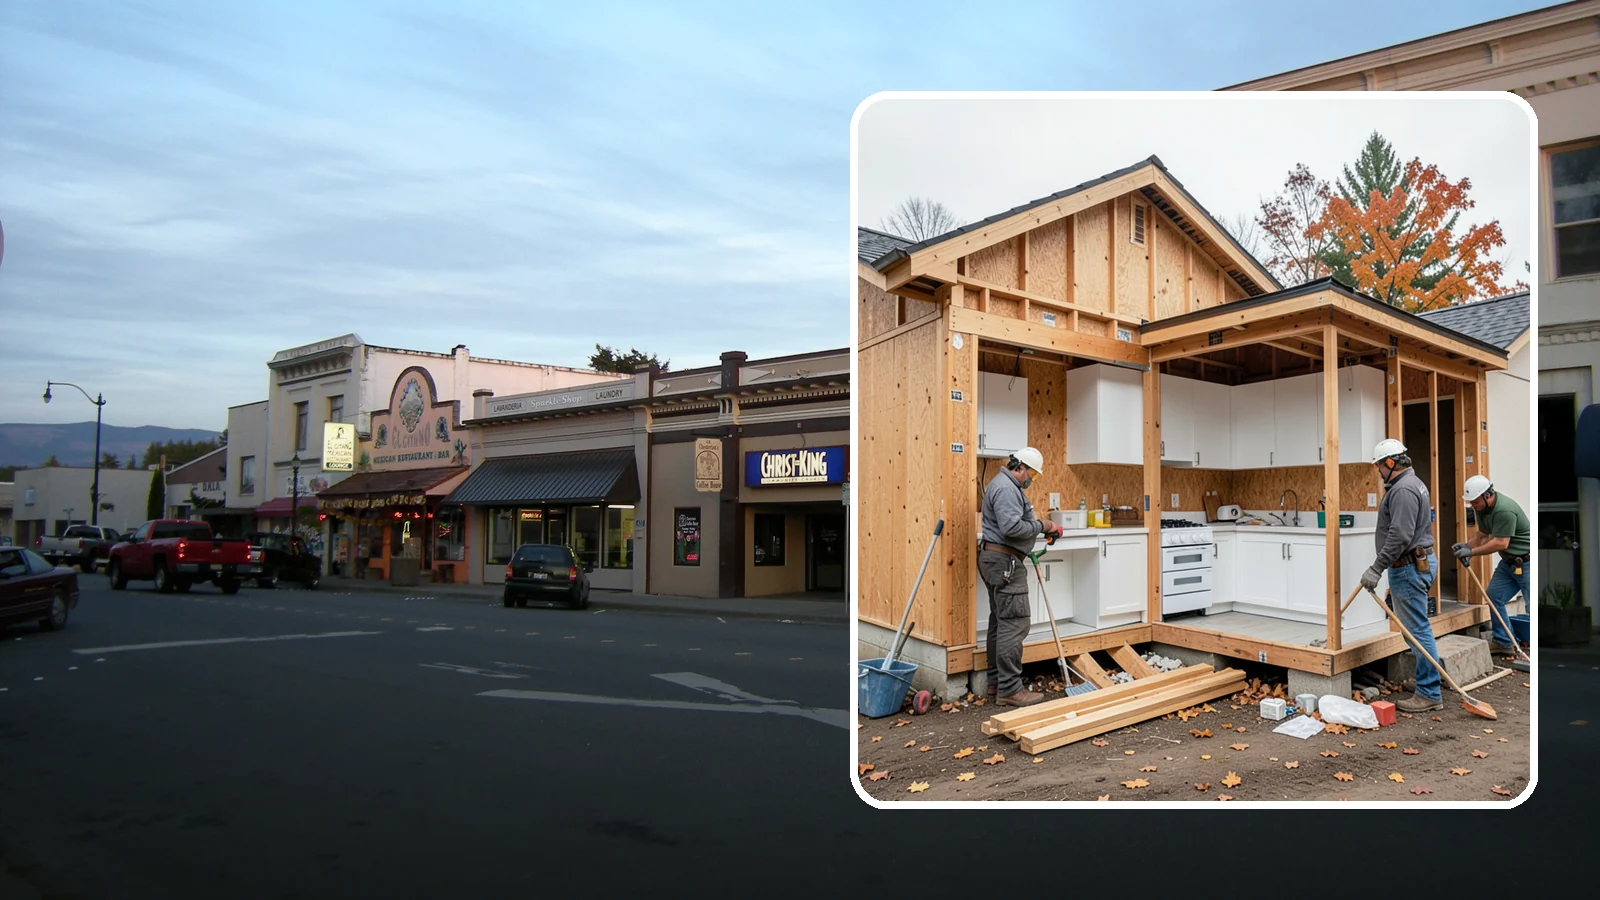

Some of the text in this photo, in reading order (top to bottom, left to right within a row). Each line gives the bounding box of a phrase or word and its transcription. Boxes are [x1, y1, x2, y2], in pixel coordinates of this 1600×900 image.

[494, 390, 623, 412] LAVANDERIA Sparkle Shop LAUNDRY
[373, 450, 450, 464] MEXICAN RESTAURANT BAR
[761, 450, 827, 477] CHRIST KING
[696, 480, 722, 489] Coffee House
